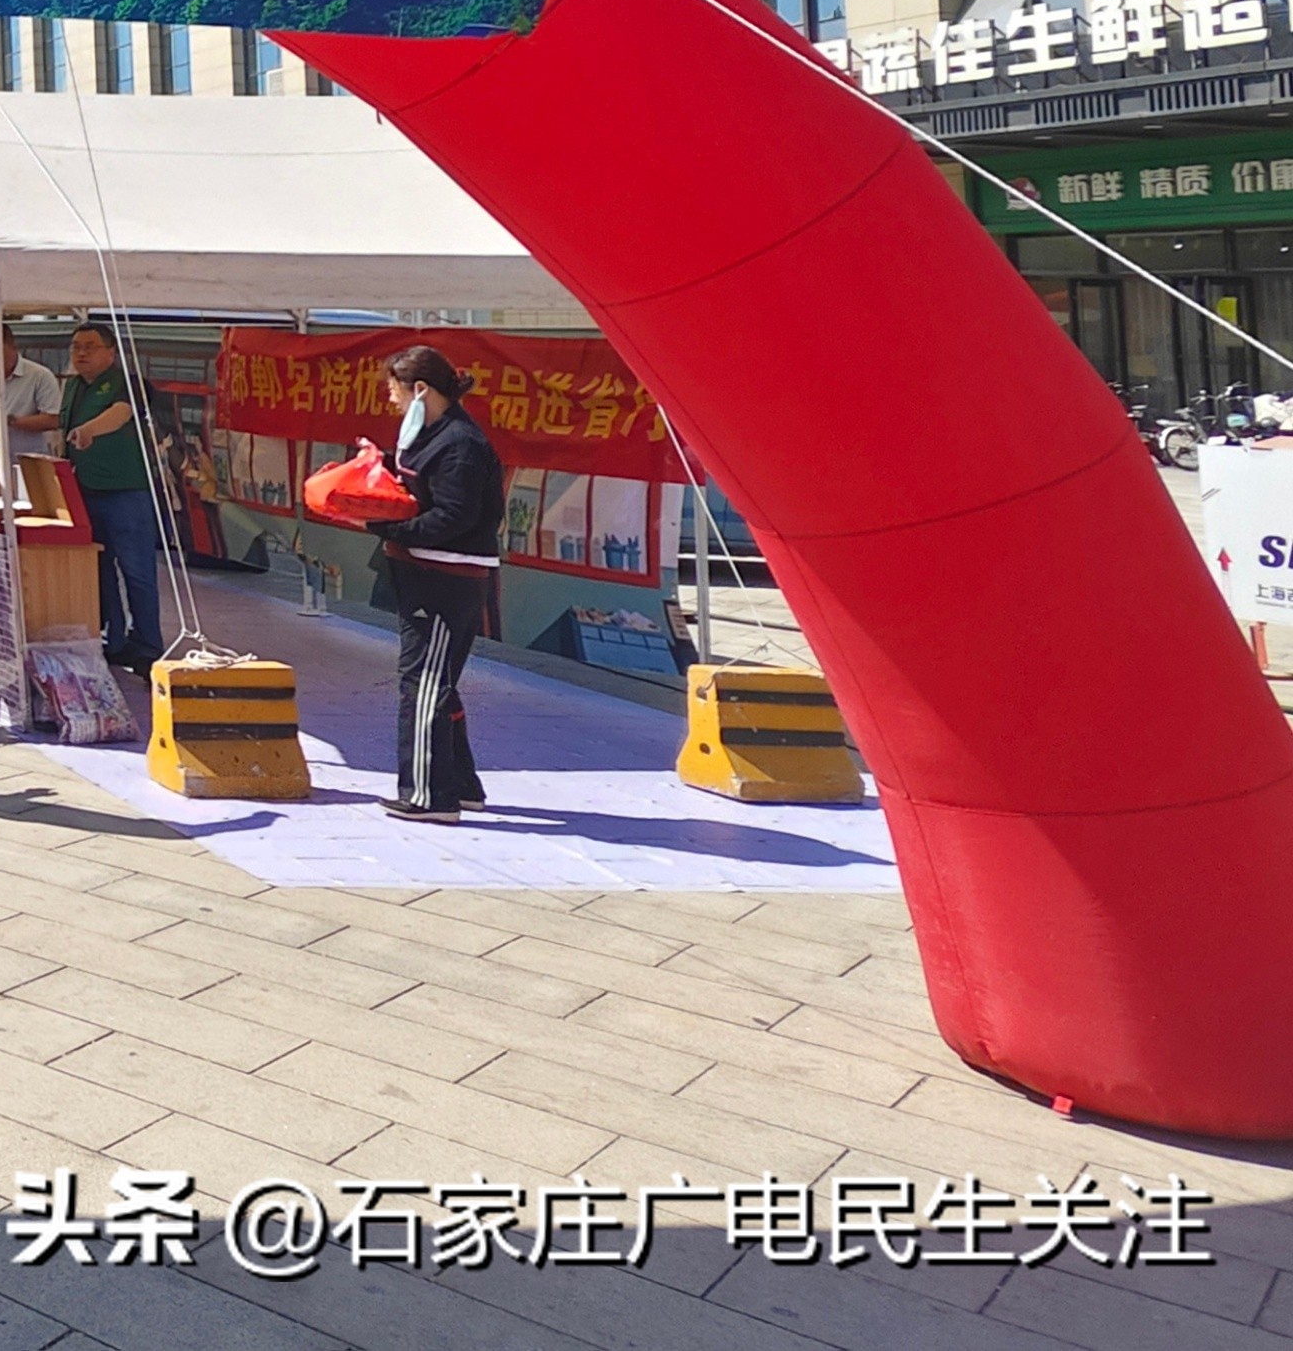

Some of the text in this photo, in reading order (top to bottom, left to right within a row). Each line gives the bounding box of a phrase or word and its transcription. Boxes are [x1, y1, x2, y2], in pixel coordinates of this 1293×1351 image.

[1058, 171, 1124, 203] 新鲜
[1139, 164, 1211, 199] 精质
[1259, 535, 1293, 569] S
